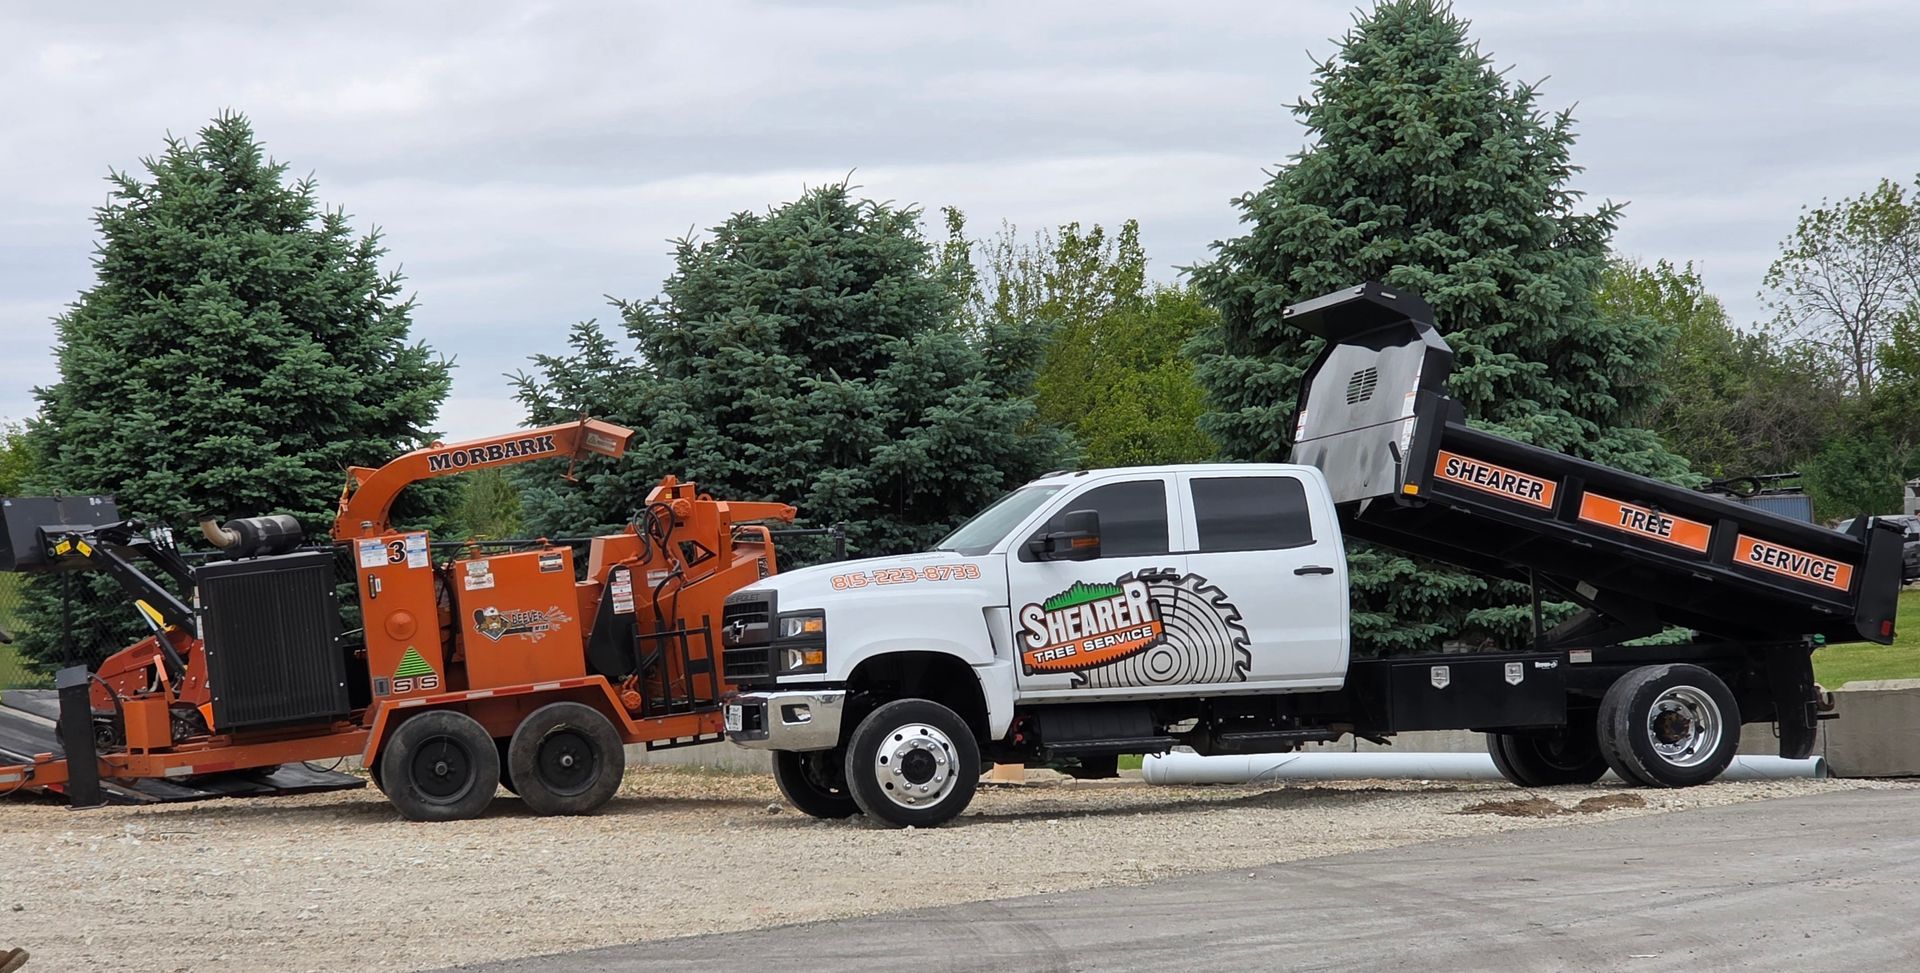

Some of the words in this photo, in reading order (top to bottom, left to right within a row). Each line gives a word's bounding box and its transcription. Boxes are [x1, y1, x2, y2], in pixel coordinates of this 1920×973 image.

[428, 435, 556, 472] MORBARK
[1445, 457, 1545, 502] SHEARER
[1619, 504, 1675, 539] TREE
[1750, 542, 1838, 584] SERVICE
[387, 540, 407, 564] 3
[830, 564, 981, 590] 815-223-8733
[510, 610, 545, 625] BEEVER
[1033, 645, 1077, 664] TREE
[1082, 626, 1153, 652] SERVICE
